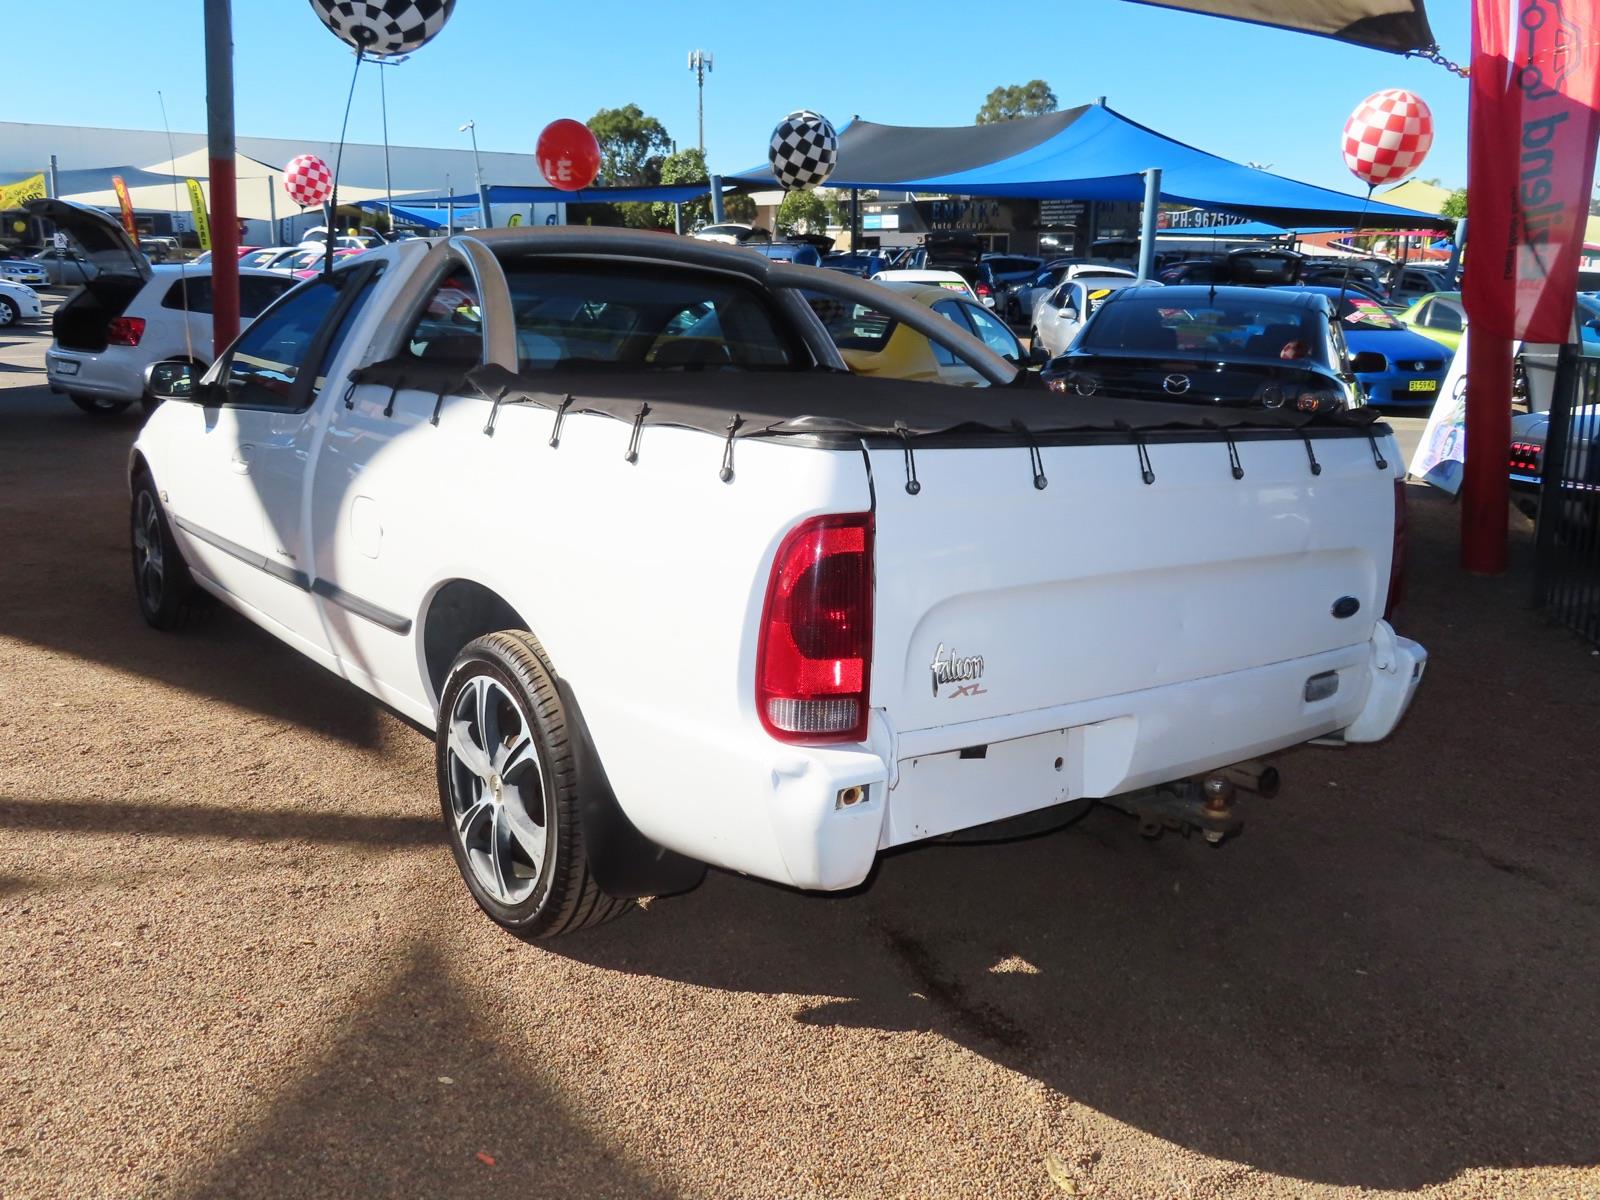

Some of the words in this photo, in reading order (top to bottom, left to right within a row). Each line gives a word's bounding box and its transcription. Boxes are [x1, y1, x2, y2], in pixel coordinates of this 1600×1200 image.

[931, 221, 952, 230] Auto
[956, 220, 984, 231] Group
[948, 683, 988, 699] XL
